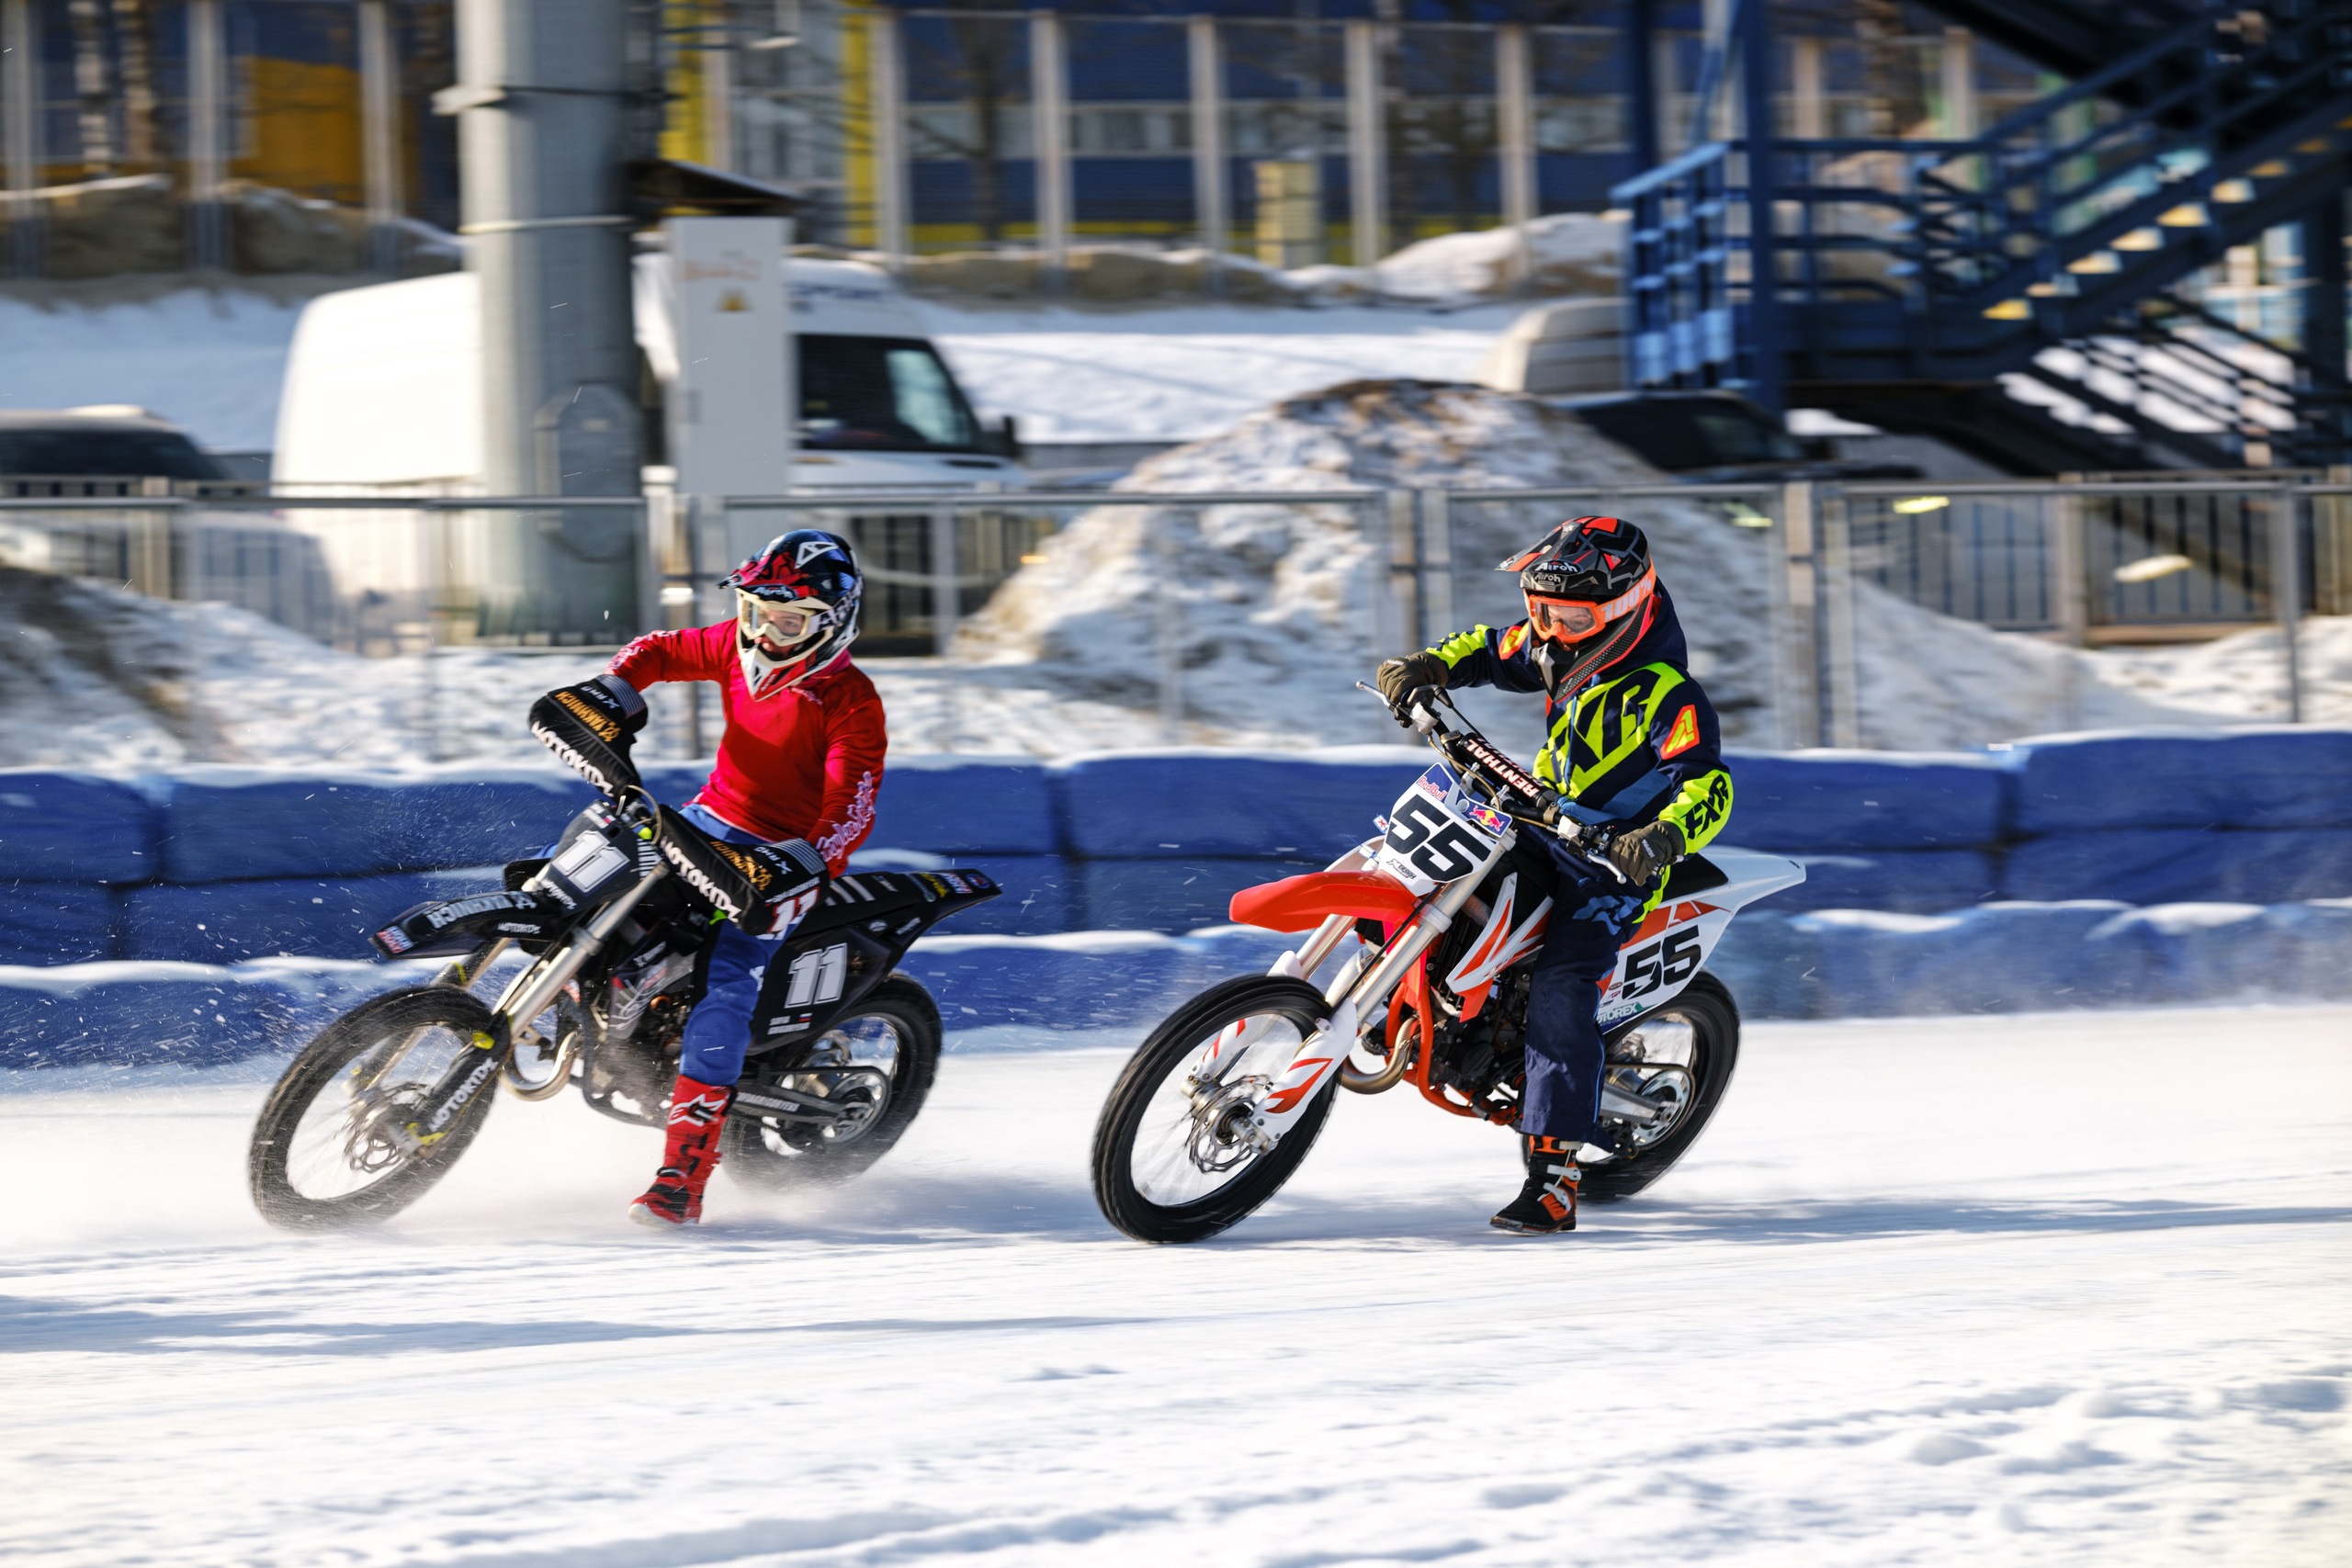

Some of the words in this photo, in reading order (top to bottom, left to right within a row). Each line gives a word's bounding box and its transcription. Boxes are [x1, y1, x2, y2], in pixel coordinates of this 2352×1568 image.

[1534, 561, 1578, 573] Airoh
[1534, 572, 1562, 583] Airoh
[1601, 575, 1652, 623] 100%
[1465, 738, 1541, 798] RENTHAL
[1385, 793, 1493, 882] 55
[1680, 774, 1730, 840] FXR
[551, 829, 631, 895] 11
[784, 942, 847, 1009] 11
[1622, 924, 1702, 1000] 55
